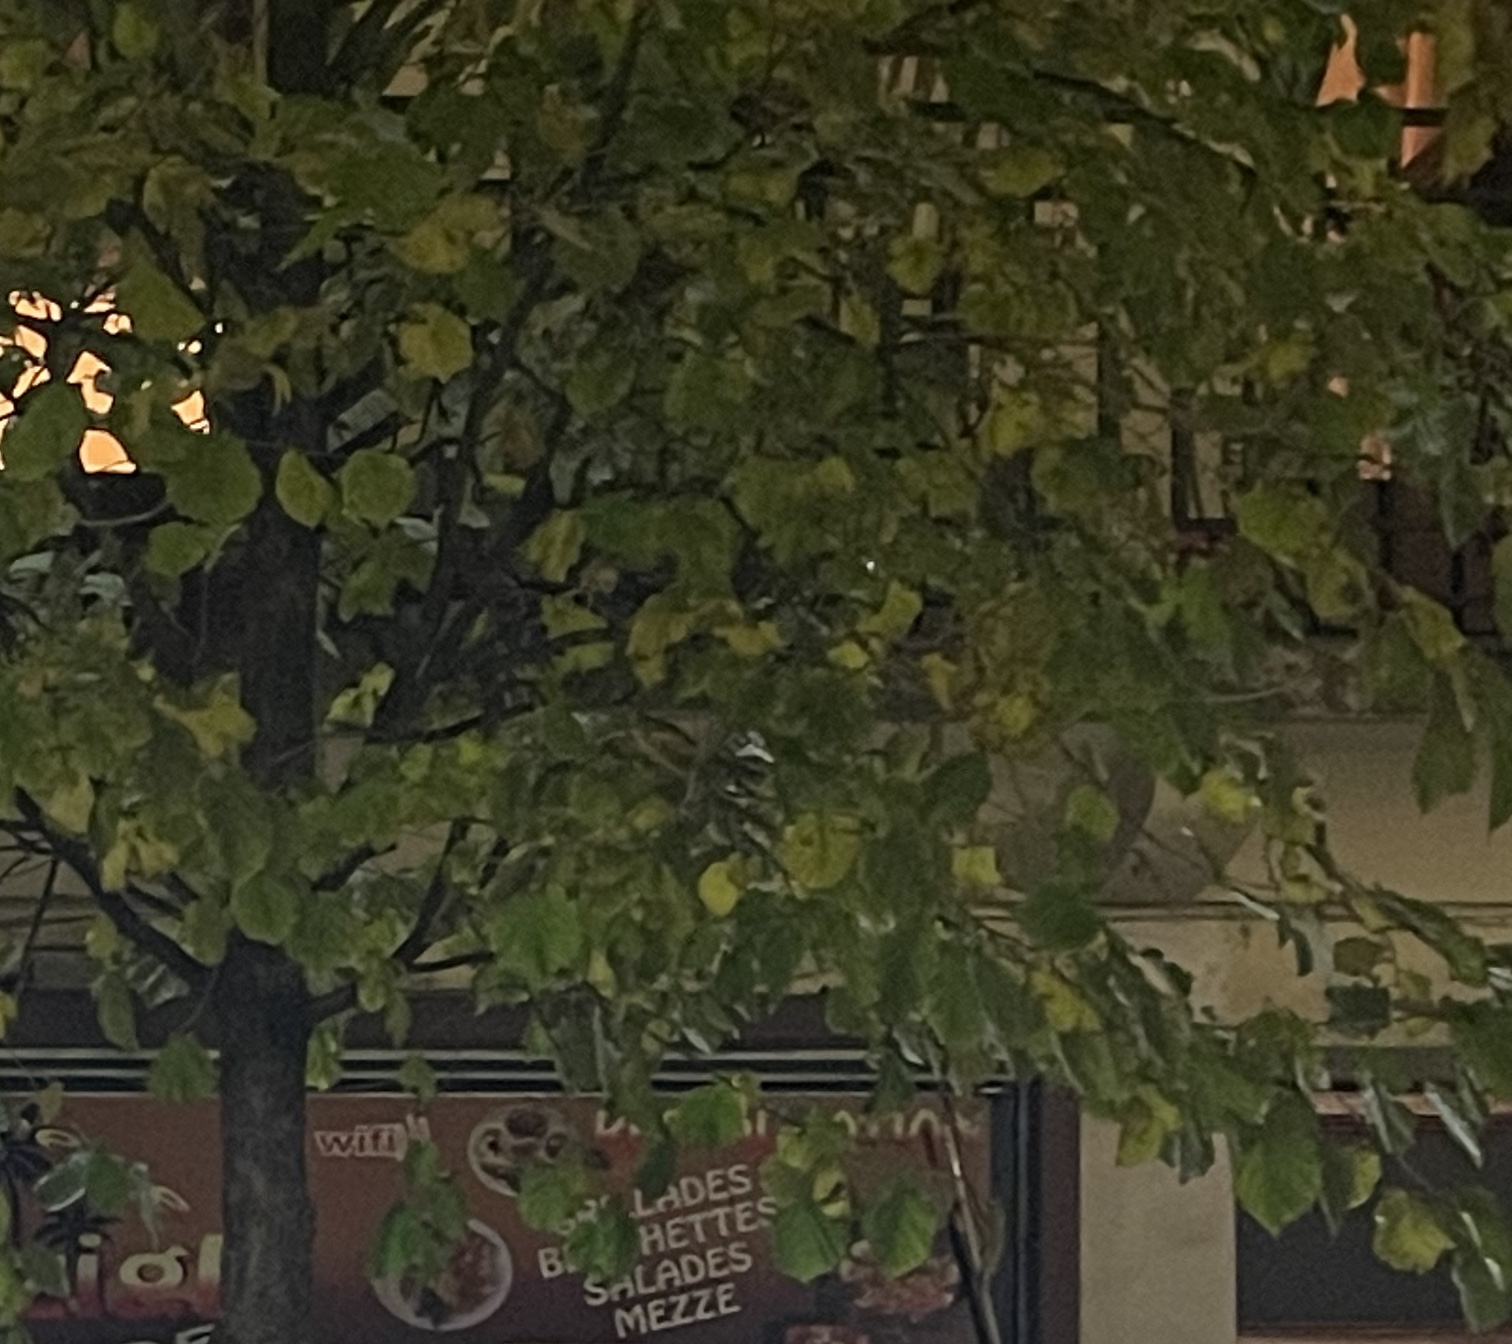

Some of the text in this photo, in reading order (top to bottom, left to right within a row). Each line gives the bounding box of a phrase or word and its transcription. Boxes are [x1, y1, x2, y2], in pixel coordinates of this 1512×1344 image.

[317, 1125, 399, 1157] wifi
[557, 1165, 753, 1236] LADES
[538, 1196, 778, 1279] BHETTES
[583, 1242, 753, 1306] SALADES
[614, 1282, 742, 1339] MEZZE
